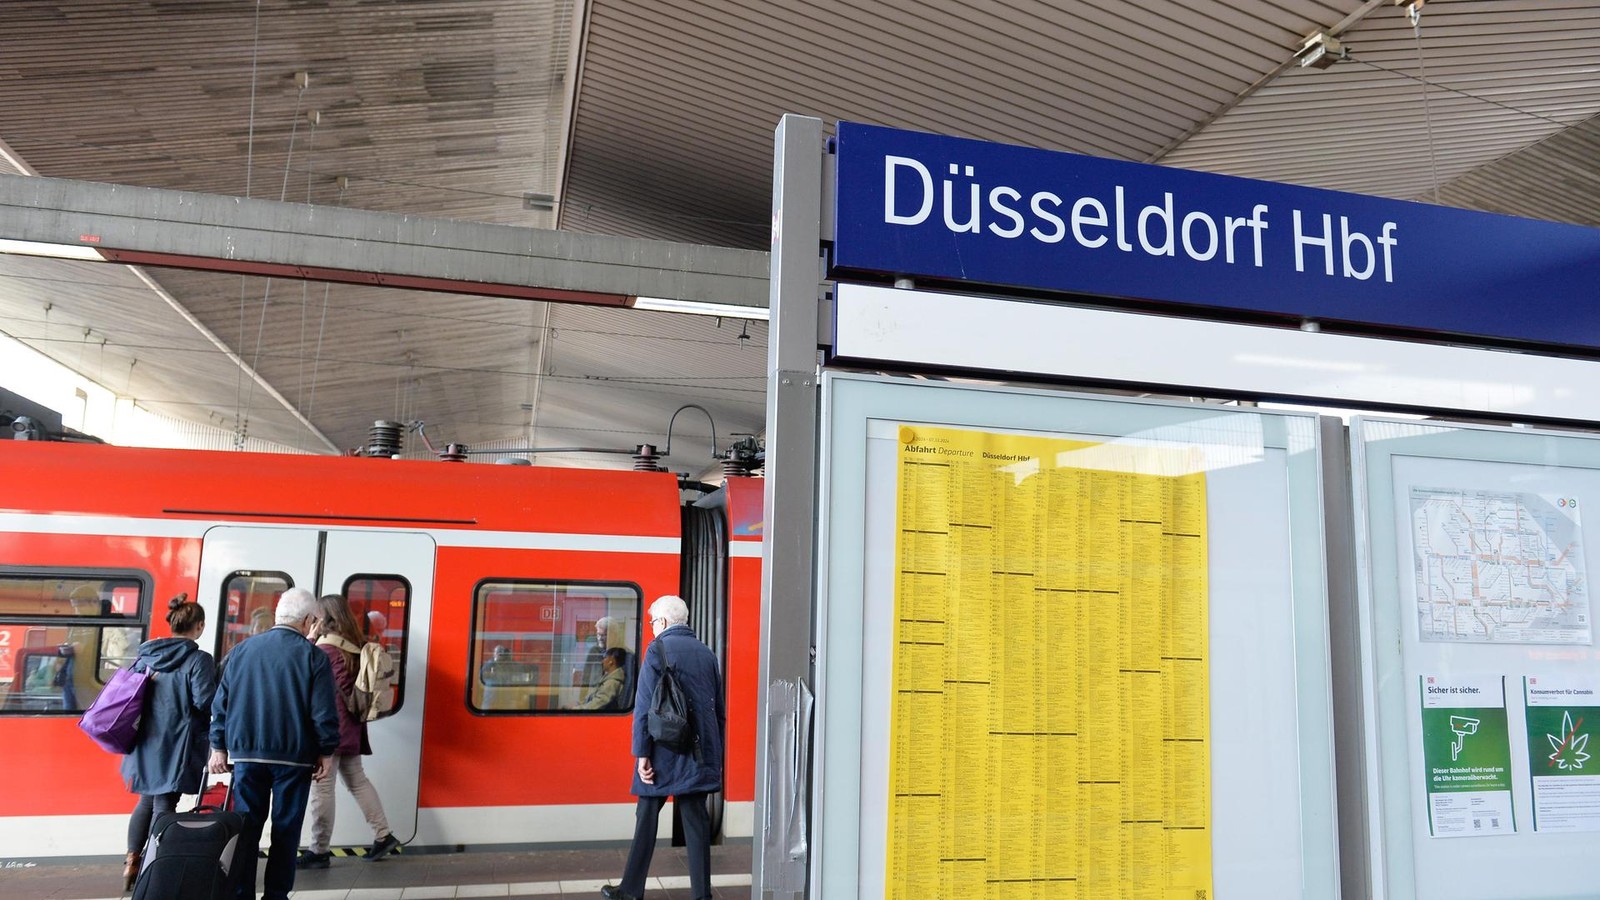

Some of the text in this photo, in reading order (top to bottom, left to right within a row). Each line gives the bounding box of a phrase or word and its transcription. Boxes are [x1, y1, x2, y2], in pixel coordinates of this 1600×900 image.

[884, 155, 1398, 282] Düsseldorf Hbf
[904, 444, 974, 458] Abfahrt Departure
[982, 452, 1016, 462] Düsseldorf
[1450, 686, 1458, 694] ist
[1460, 686, 1481, 694] sicher.
